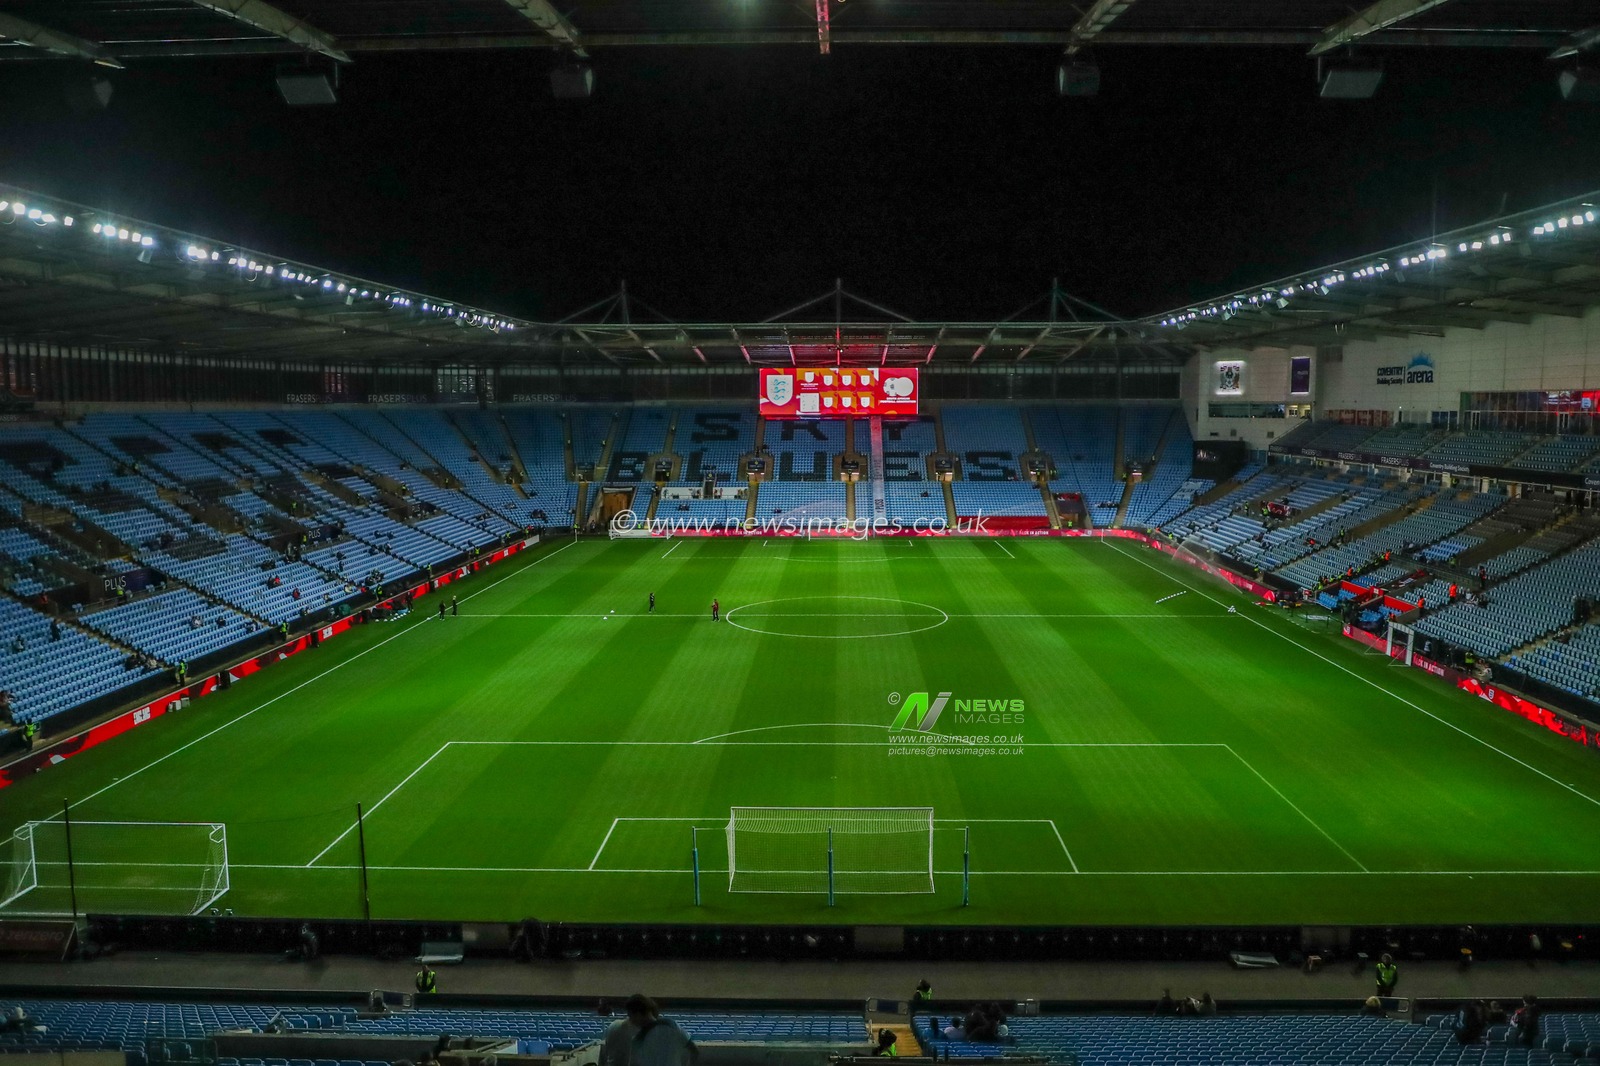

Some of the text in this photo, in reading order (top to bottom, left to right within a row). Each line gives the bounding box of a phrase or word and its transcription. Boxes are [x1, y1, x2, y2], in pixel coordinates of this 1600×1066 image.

[1407, 370, 1434, 383] arena
[606, 450, 1018, 482] BLUES
[104, 575, 127, 592] PLUS
